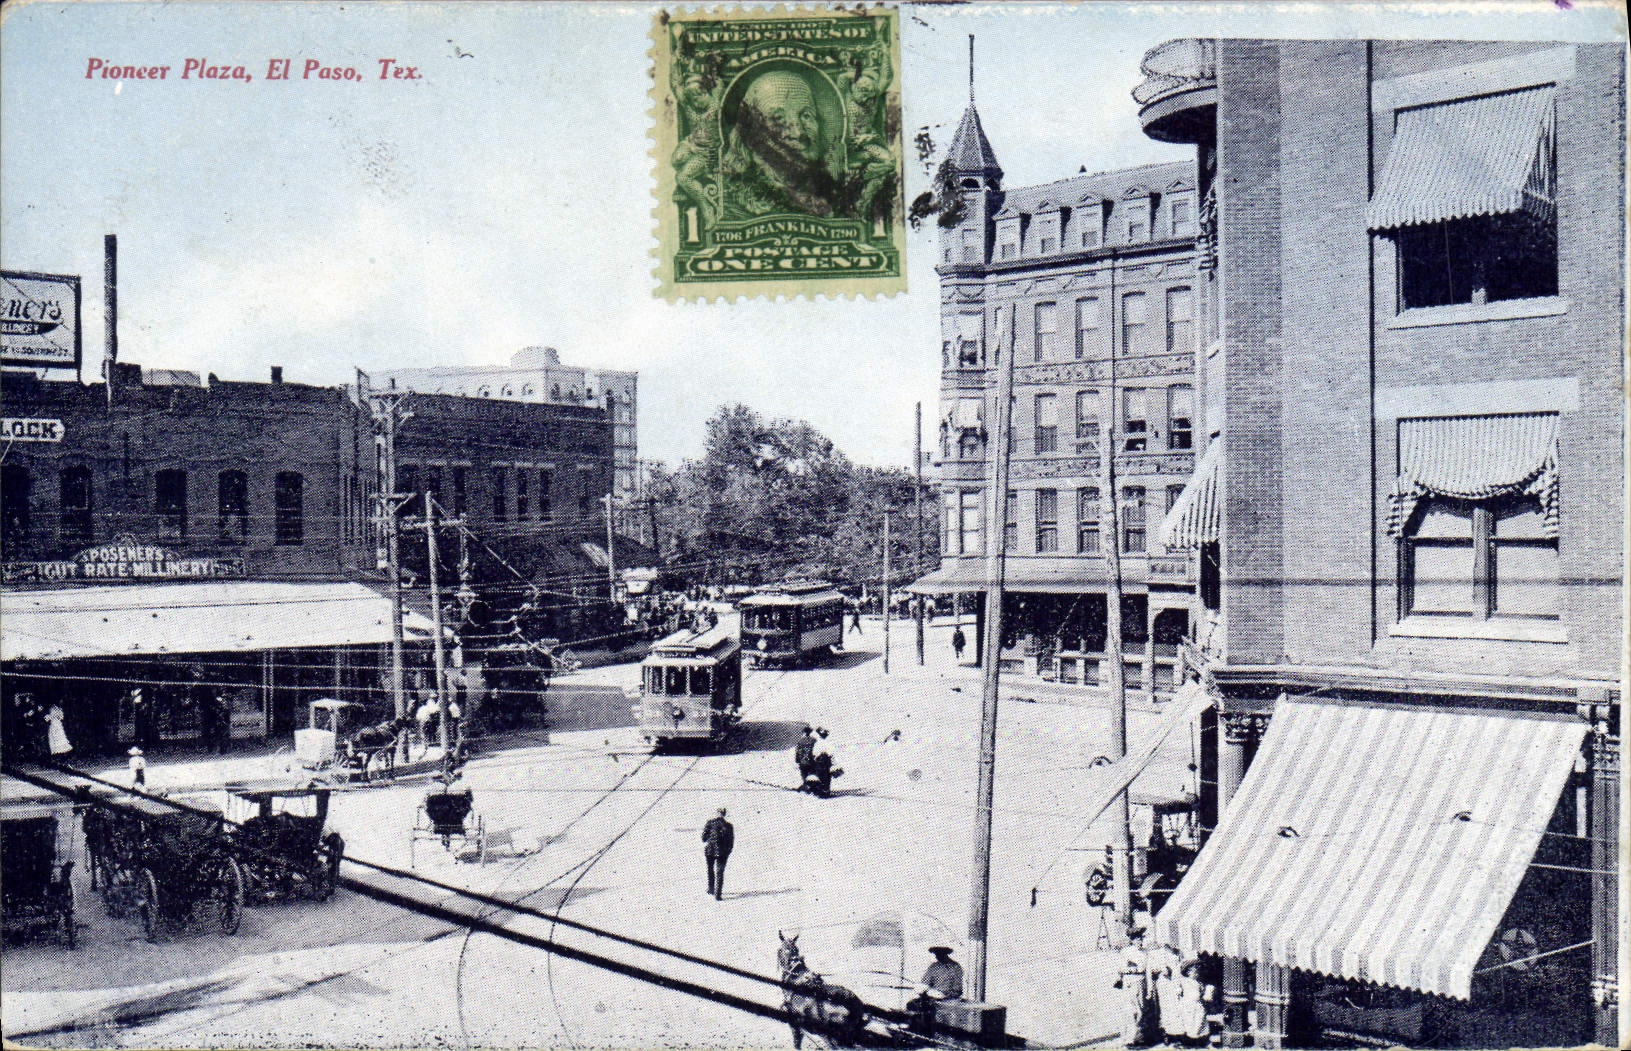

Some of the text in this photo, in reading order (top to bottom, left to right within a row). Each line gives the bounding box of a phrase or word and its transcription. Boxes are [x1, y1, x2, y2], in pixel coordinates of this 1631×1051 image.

[687, 27, 872, 43] UNITED STATES OF
[727, 46, 837, 67] AMERICA
[685, 206, 700, 243] 1
[715, 221, 858, 243] 1706 FRANKLIN 1790
[724, 245, 850, 259] POSTAGE
[697, 256, 878, 272] ONE CENT
[44, 559, 211, 579] CUT RATE MILLINERY
